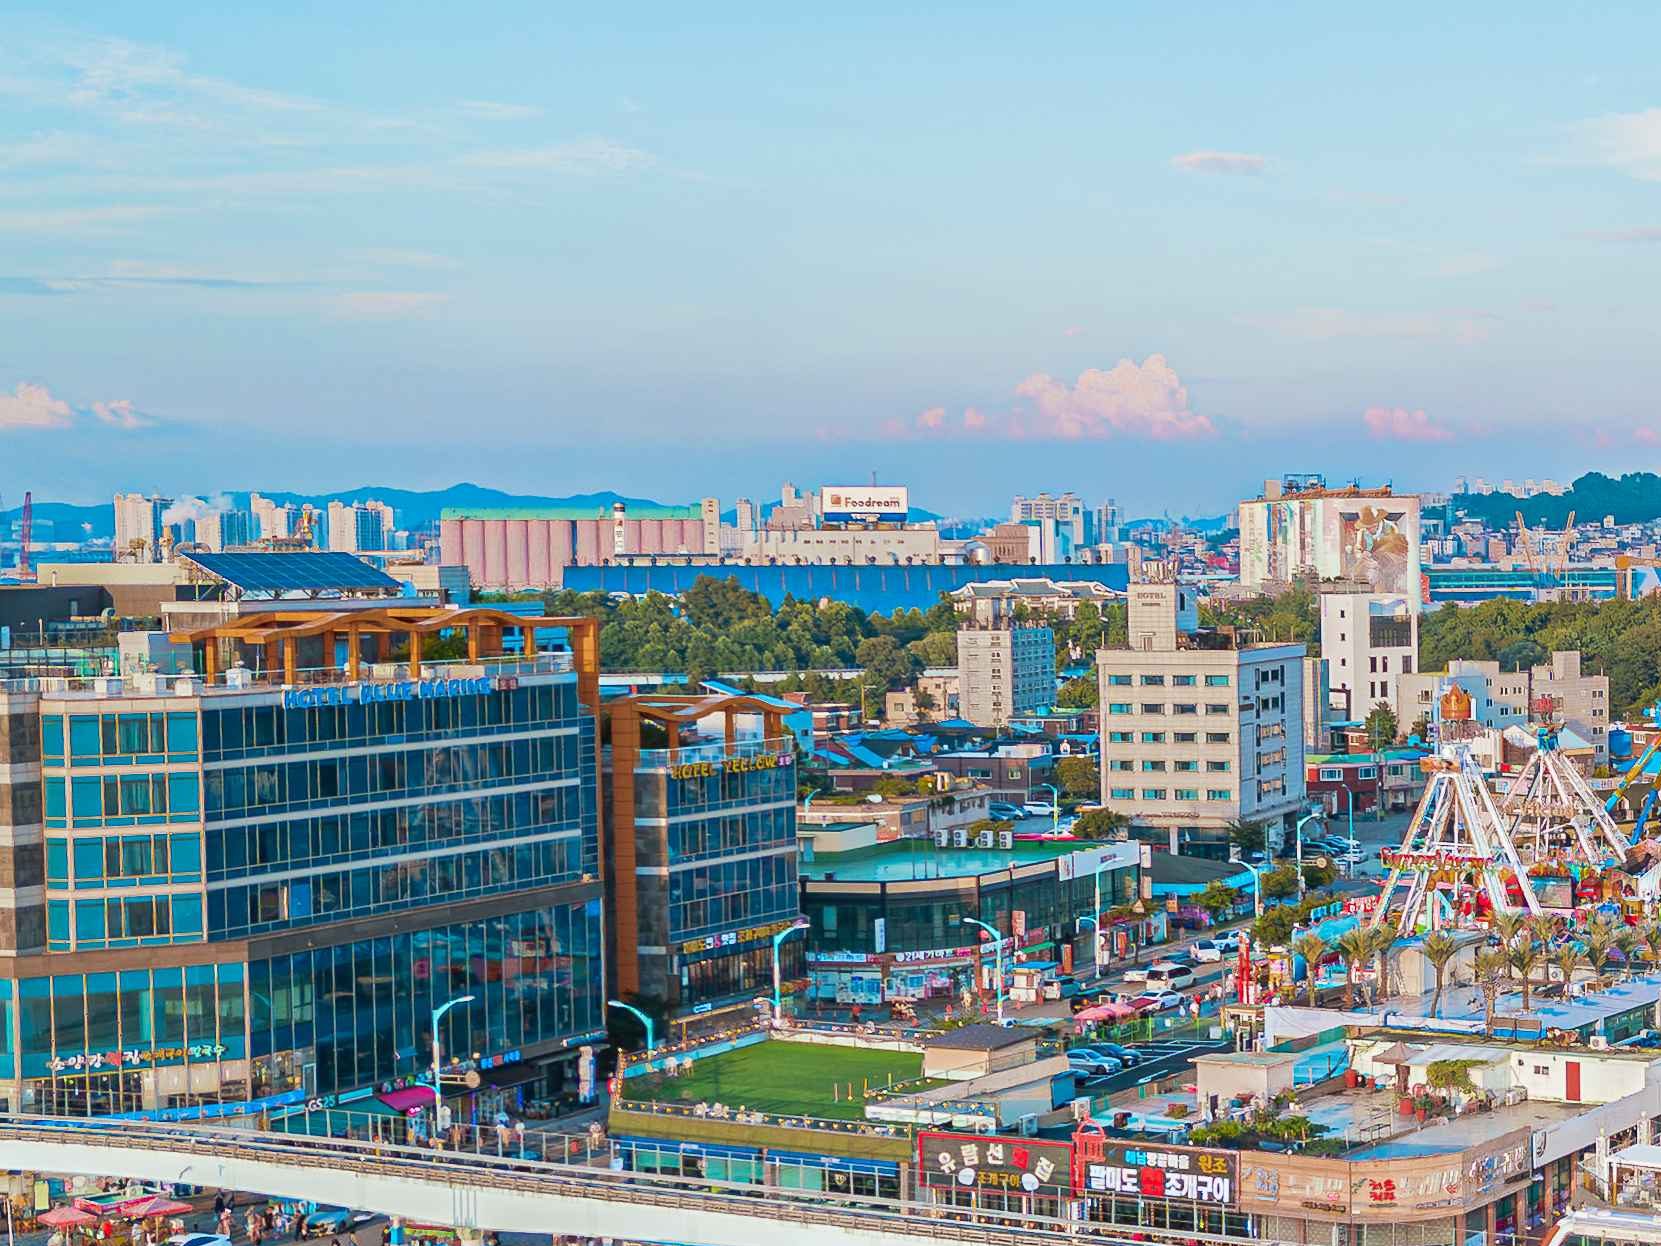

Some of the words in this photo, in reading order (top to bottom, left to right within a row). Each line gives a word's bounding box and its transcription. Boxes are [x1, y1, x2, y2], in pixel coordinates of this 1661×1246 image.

[844, 496, 900, 508] Foodream
[1137, 592, 1167, 600] HOTEL
[282, 686, 353, 710] HOTEL
[359, 682, 413, 705] BLUE
[417, 676, 491, 699] MARINE
[671, 762, 716, 779] HOTEL
[720, 754, 777, 774] YELLOW
[308, 1095, 336, 1112] GS25
[1198, 1153, 1228, 1174] 원조
